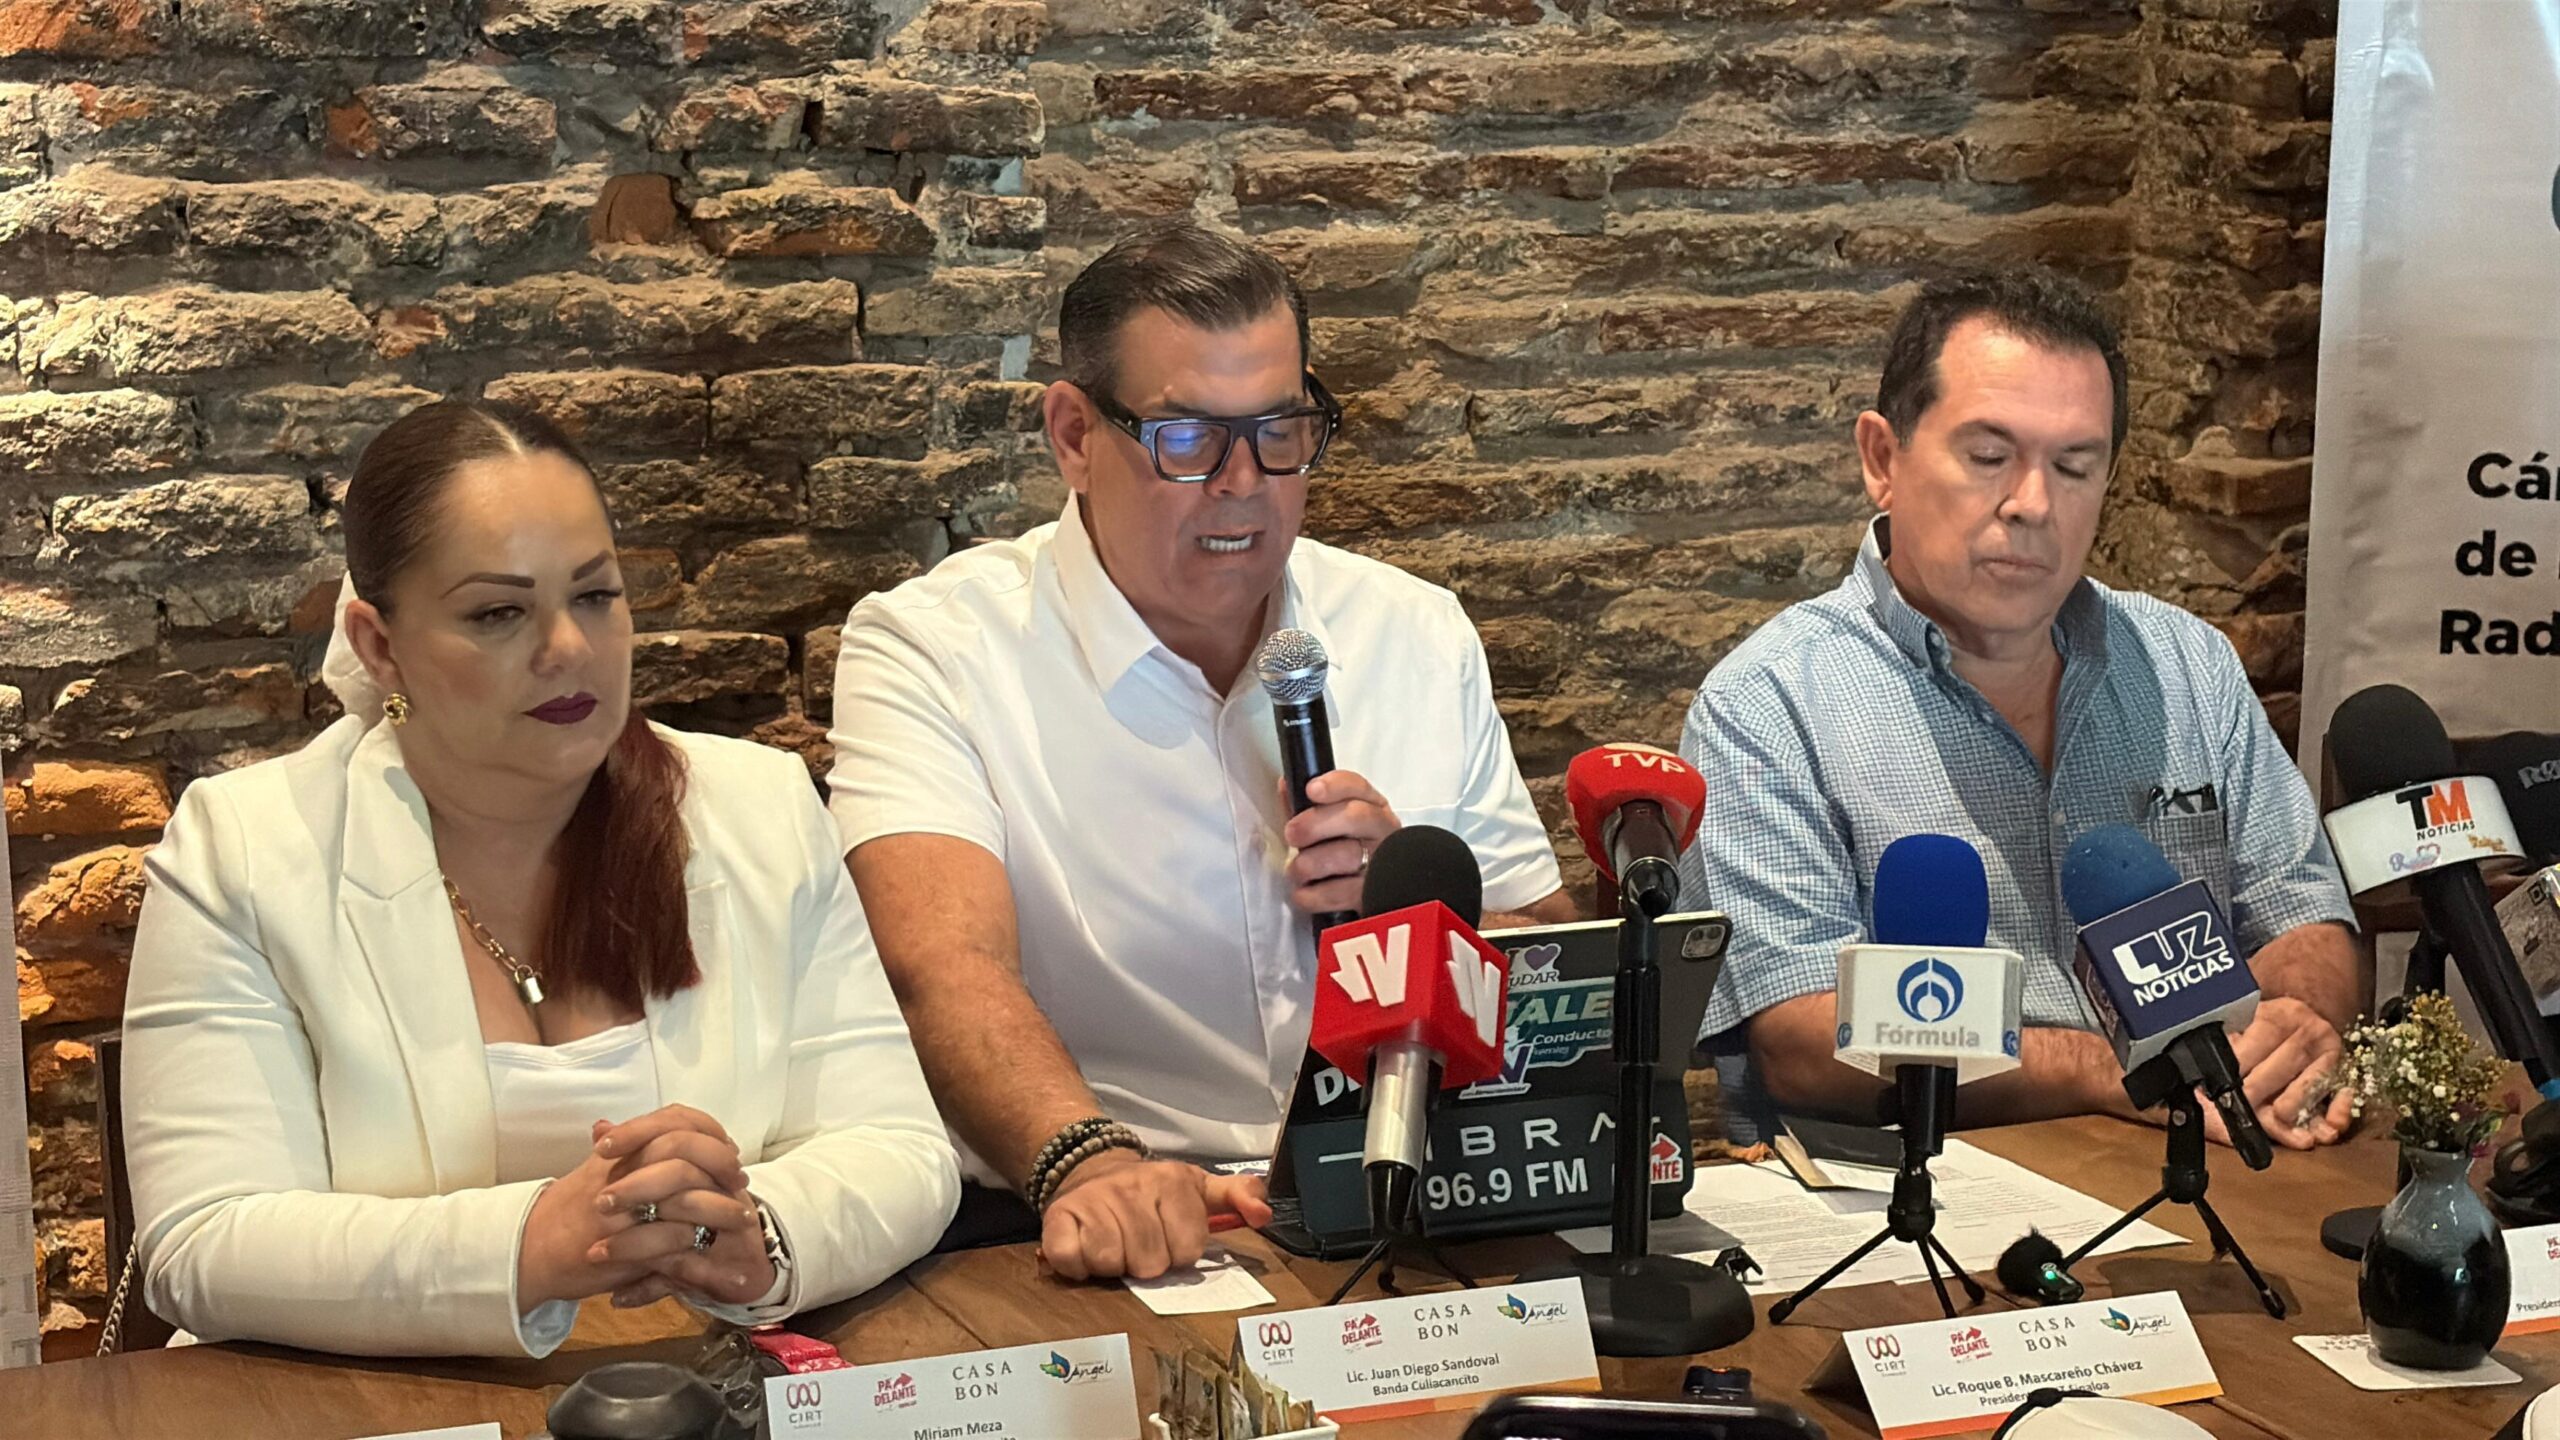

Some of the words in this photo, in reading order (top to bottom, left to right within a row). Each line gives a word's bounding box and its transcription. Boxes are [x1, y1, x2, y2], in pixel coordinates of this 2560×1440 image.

[2467, 452, 2560, 500] Cá
[2455, 530, 2537, 577] de
[1603, 752, 1686, 773] TVP
[2395, 779, 2473, 830] TM
[2416, 820, 2476, 841] NOTICIAS
[2112, 911, 2227, 985] LUZ
[2133, 950, 2235, 1007] NOTICIAS
[1533, 1028, 1612, 1045] Conducto
[1875, 1022, 1981, 1047] Fórmula
[1426, 1168, 1512, 1210] 96.9
[1526, 1158, 1589, 1198] FM
[1414, 1303, 1472, 1321] CASA
[1342, 1325, 1381, 1345] DELANTE
[1418, 1323, 1459, 1340] BON
[2018, 1316, 2076, 1334] CASA
[1951, 1337, 1990, 1357] DELANTE
[2025, 1335, 2068, 1351] BON
[1263, 1348, 1295, 1361] CIRT
[952, 1361, 1012, 1380] CASA
[1347, 1370, 1368, 1383] Lic.
[1370, 1367, 1400, 1380] Juan
[1403, 1362, 1440, 1376] Diego
[1442, 1352, 1500, 1371] Sandoval
[1875, 1360, 1906, 1372] CIRT
[1373, 1382, 1408, 1396] Banda
[1411, 1374, 1480, 1391] Culiacancito
[1932, 1384, 1956, 1397] Lic.
[1958, 1378, 2002, 1395] Roque
[2004, 1376, 2018, 1388] B.
[2020, 1365, 2093, 1385] Mascareño
[2094, 1359, 2143, 1375] Chávez
[874, 1385, 917, 1406] DELANTE
[955, 1382, 999, 1400] BON
[1979, 1393, 2029, 1407] Presiden
[789, 1410, 822, 1423] CIRT
[914, 1424, 963, 1440] Miriam
[967, 1420, 1003, 1436] Meza
